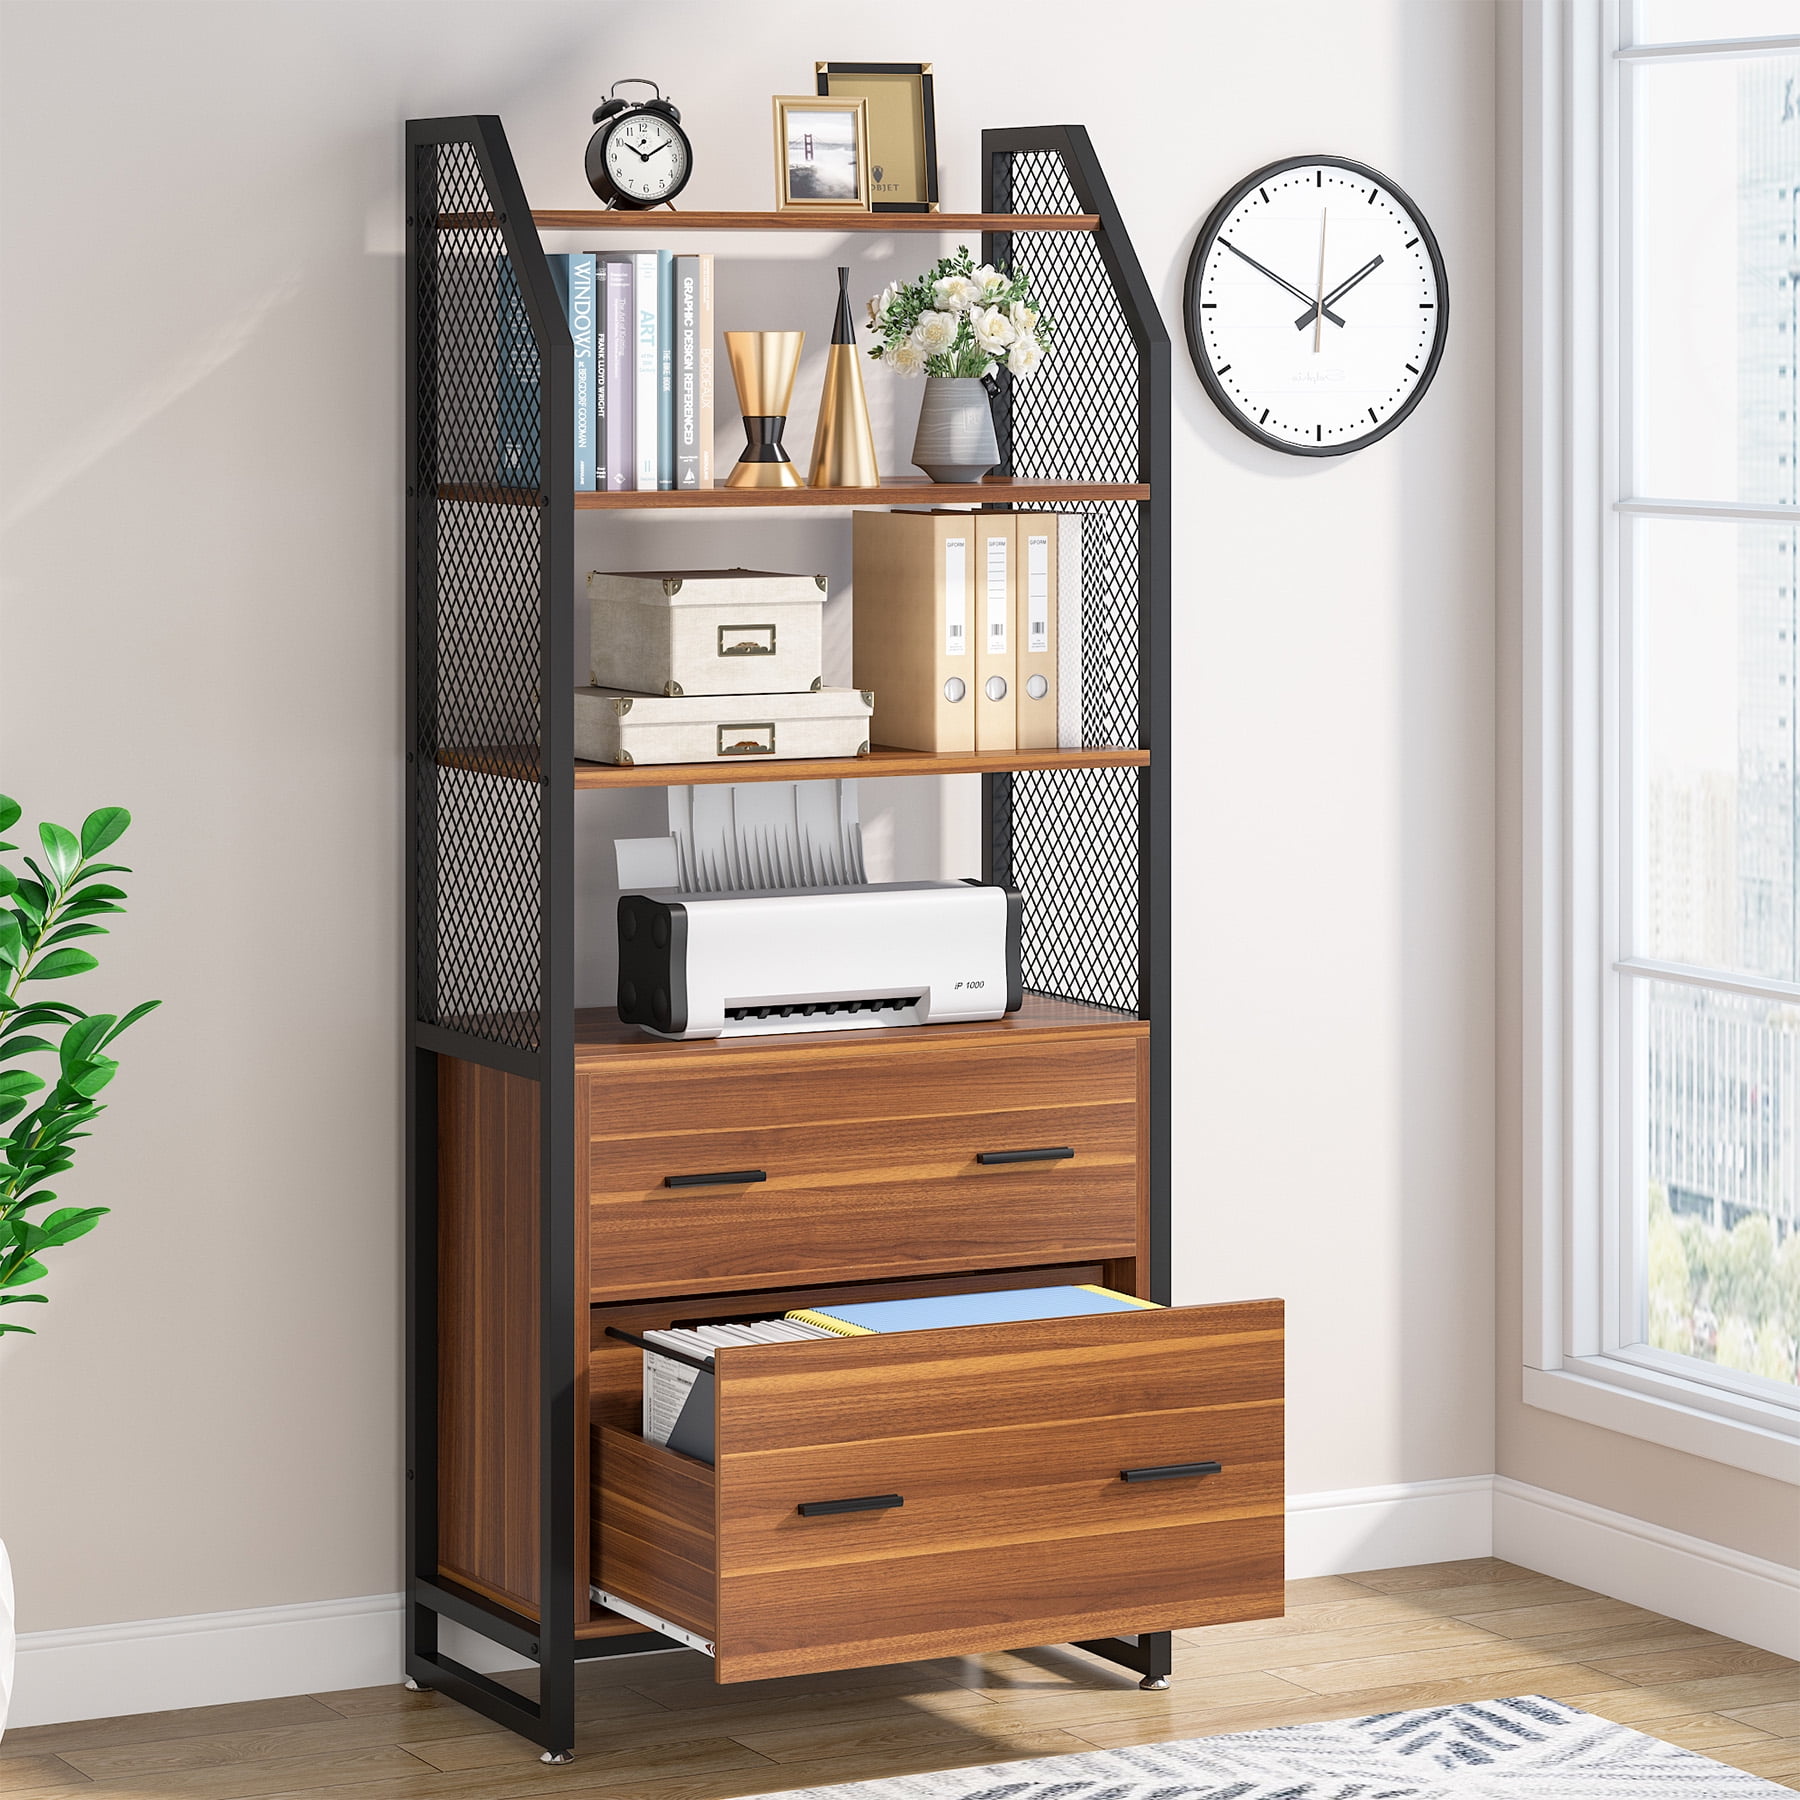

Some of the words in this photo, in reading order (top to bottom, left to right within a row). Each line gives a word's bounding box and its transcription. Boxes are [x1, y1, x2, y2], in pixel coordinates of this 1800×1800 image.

[626, 128, 634, 136] 11
[639, 124, 648, 132] 12
[616, 138, 624, 147] 10
[611, 153, 618, 162] 9
[672, 154, 678, 163] 3
[616, 168, 623, 177] 8
[628, 180, 634, 188] 7
[659, 179, 665, 188] 5
[643, 184, 650, 193] 6
[683, 277, 694, 327] GRAPHIC
[574, 261, 591, 358] WINDOWS
[640, 310, 655, 347] ART
[683, 329, 694, 370] DESIGN
[663, 349, 671, 361] THE
[701, 348, 711, 408] BORDEAUX
[578, 368, 587, 407] BERGDORF
[683, 372, 694, 445] REFERENCED
[578, 408, 587, 448] GOODMAN
[966, 980, 985, 989] 1000
